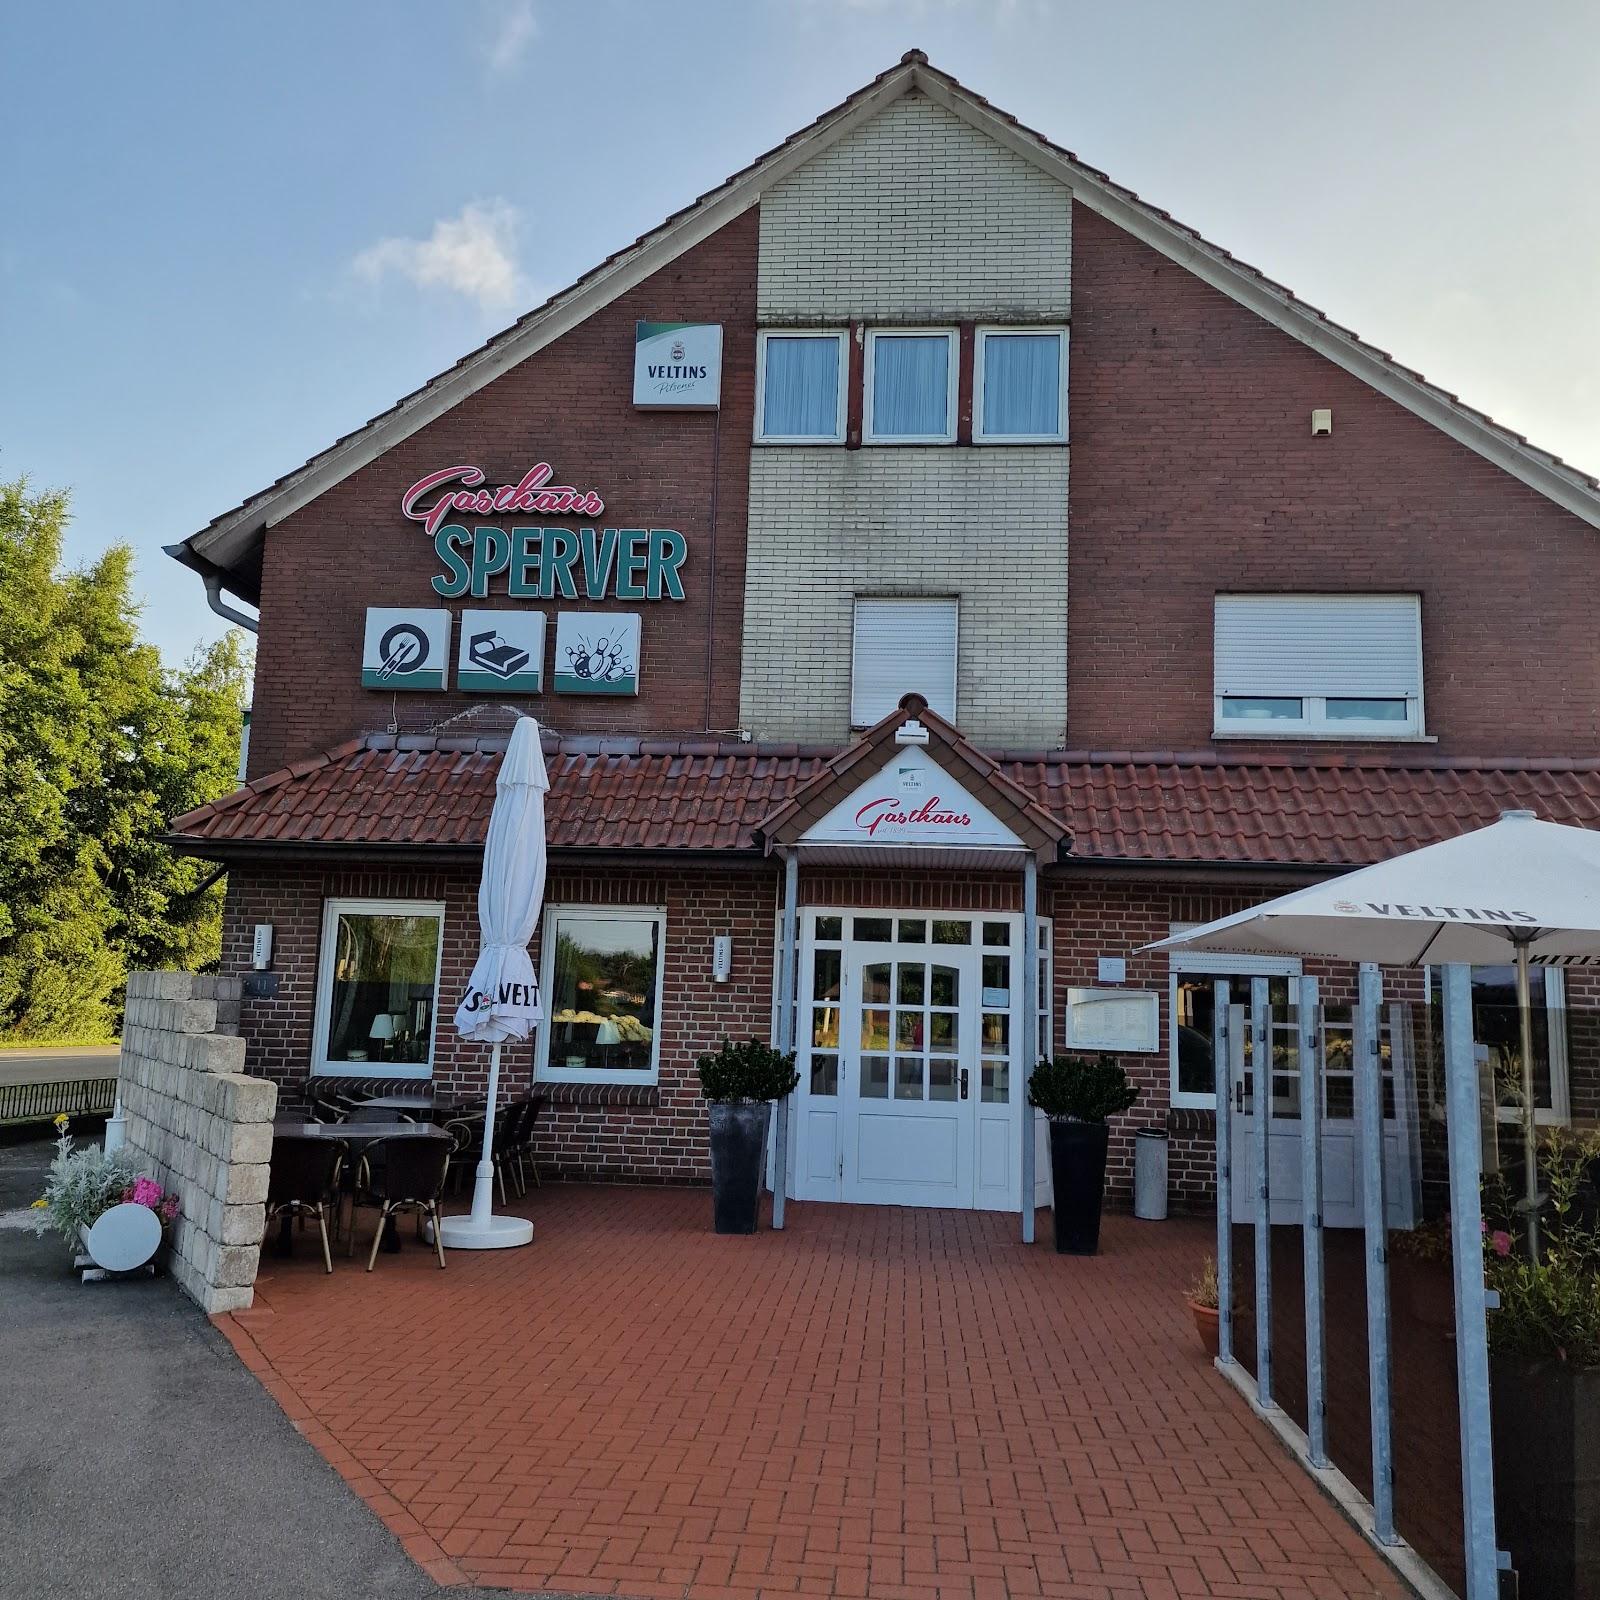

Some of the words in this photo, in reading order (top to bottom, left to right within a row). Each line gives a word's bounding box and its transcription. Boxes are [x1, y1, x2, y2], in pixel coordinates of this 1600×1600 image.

[648, 365, 707, 379] VELTINS
[402, 462, 604, 535] Gasthaus
[431, 524, 687, 600] SPERVER
[855, 796, 971, 837] Gasthaus
[1365, 903, 1538, 922] VELTINS
